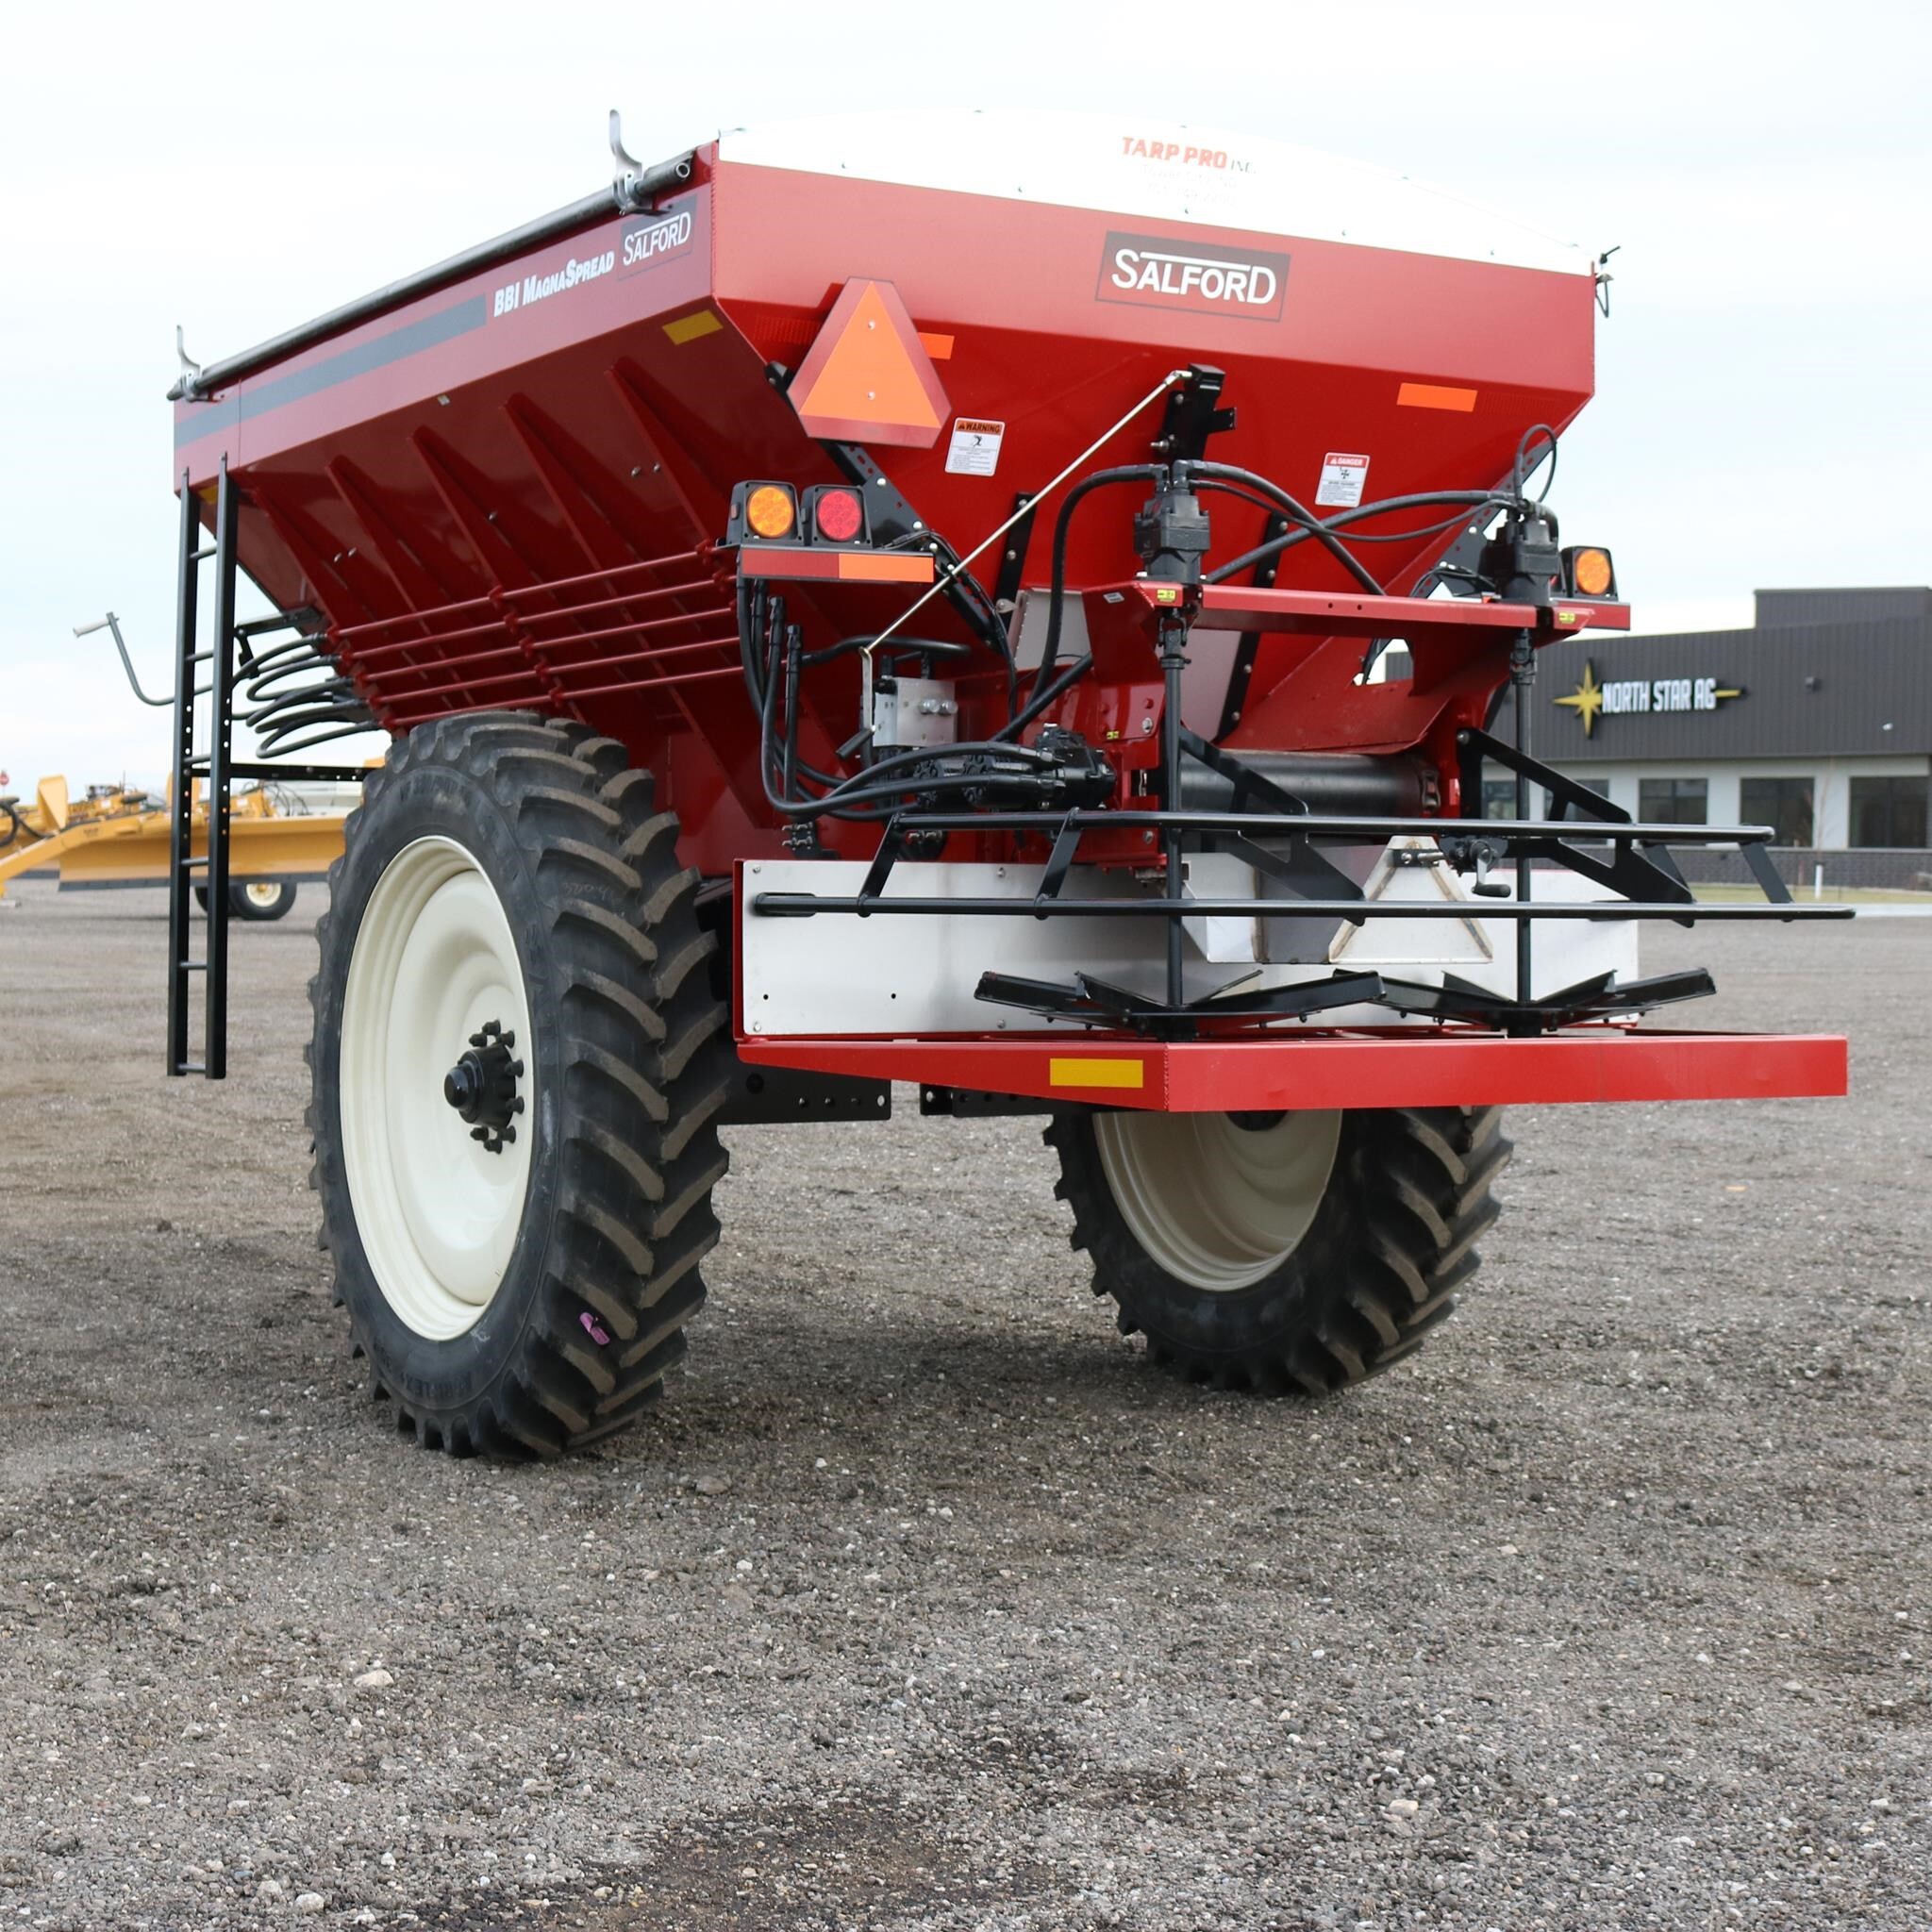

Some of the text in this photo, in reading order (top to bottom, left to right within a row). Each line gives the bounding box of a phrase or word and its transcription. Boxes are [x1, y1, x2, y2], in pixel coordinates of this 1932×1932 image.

[1122, 137, 1180, 161] TARP
[1183, 145, 1227, 169] PRO
[623, 211, 691, 266] SALFORD
[1111, 248, 1276, 305] SALFORD
[493, 282, 520, 318] BBI
[967, 422, 1000, 434] WARNING
[1338, 456, 1363, 466] DANGER
[1602, 677, 1716, 713] NORTH STAR AG
